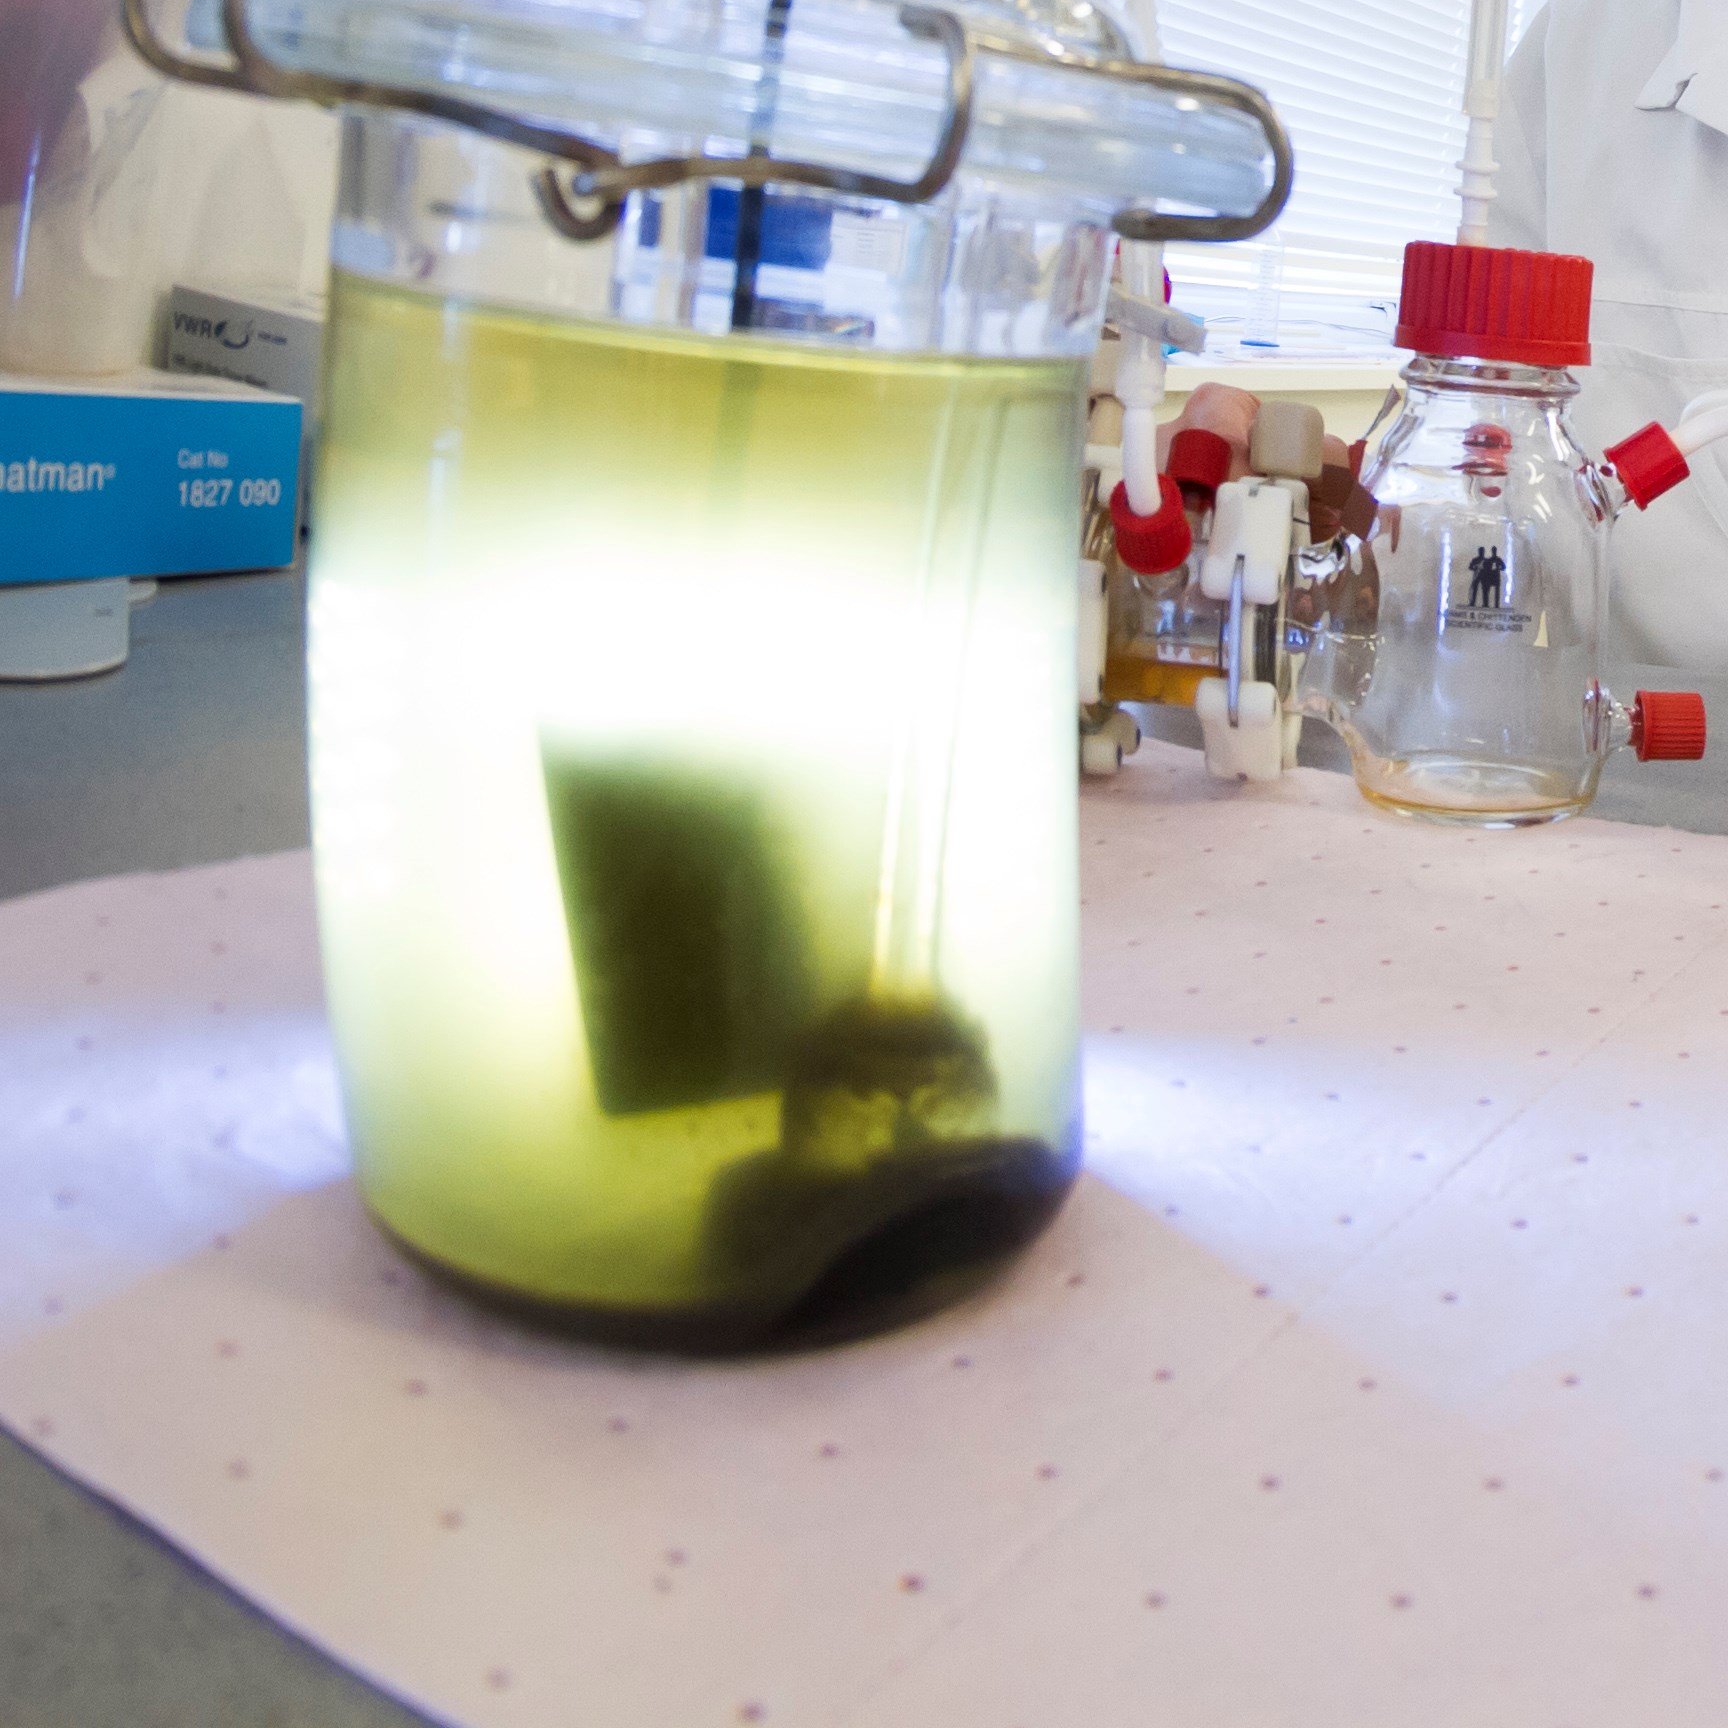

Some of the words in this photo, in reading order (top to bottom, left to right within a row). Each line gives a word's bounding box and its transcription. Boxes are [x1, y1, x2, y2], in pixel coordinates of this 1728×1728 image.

[174, 311, 213, 339] VWR
[179, 478, 233, 508] 1827
[239, 478, 282, 508] 090
